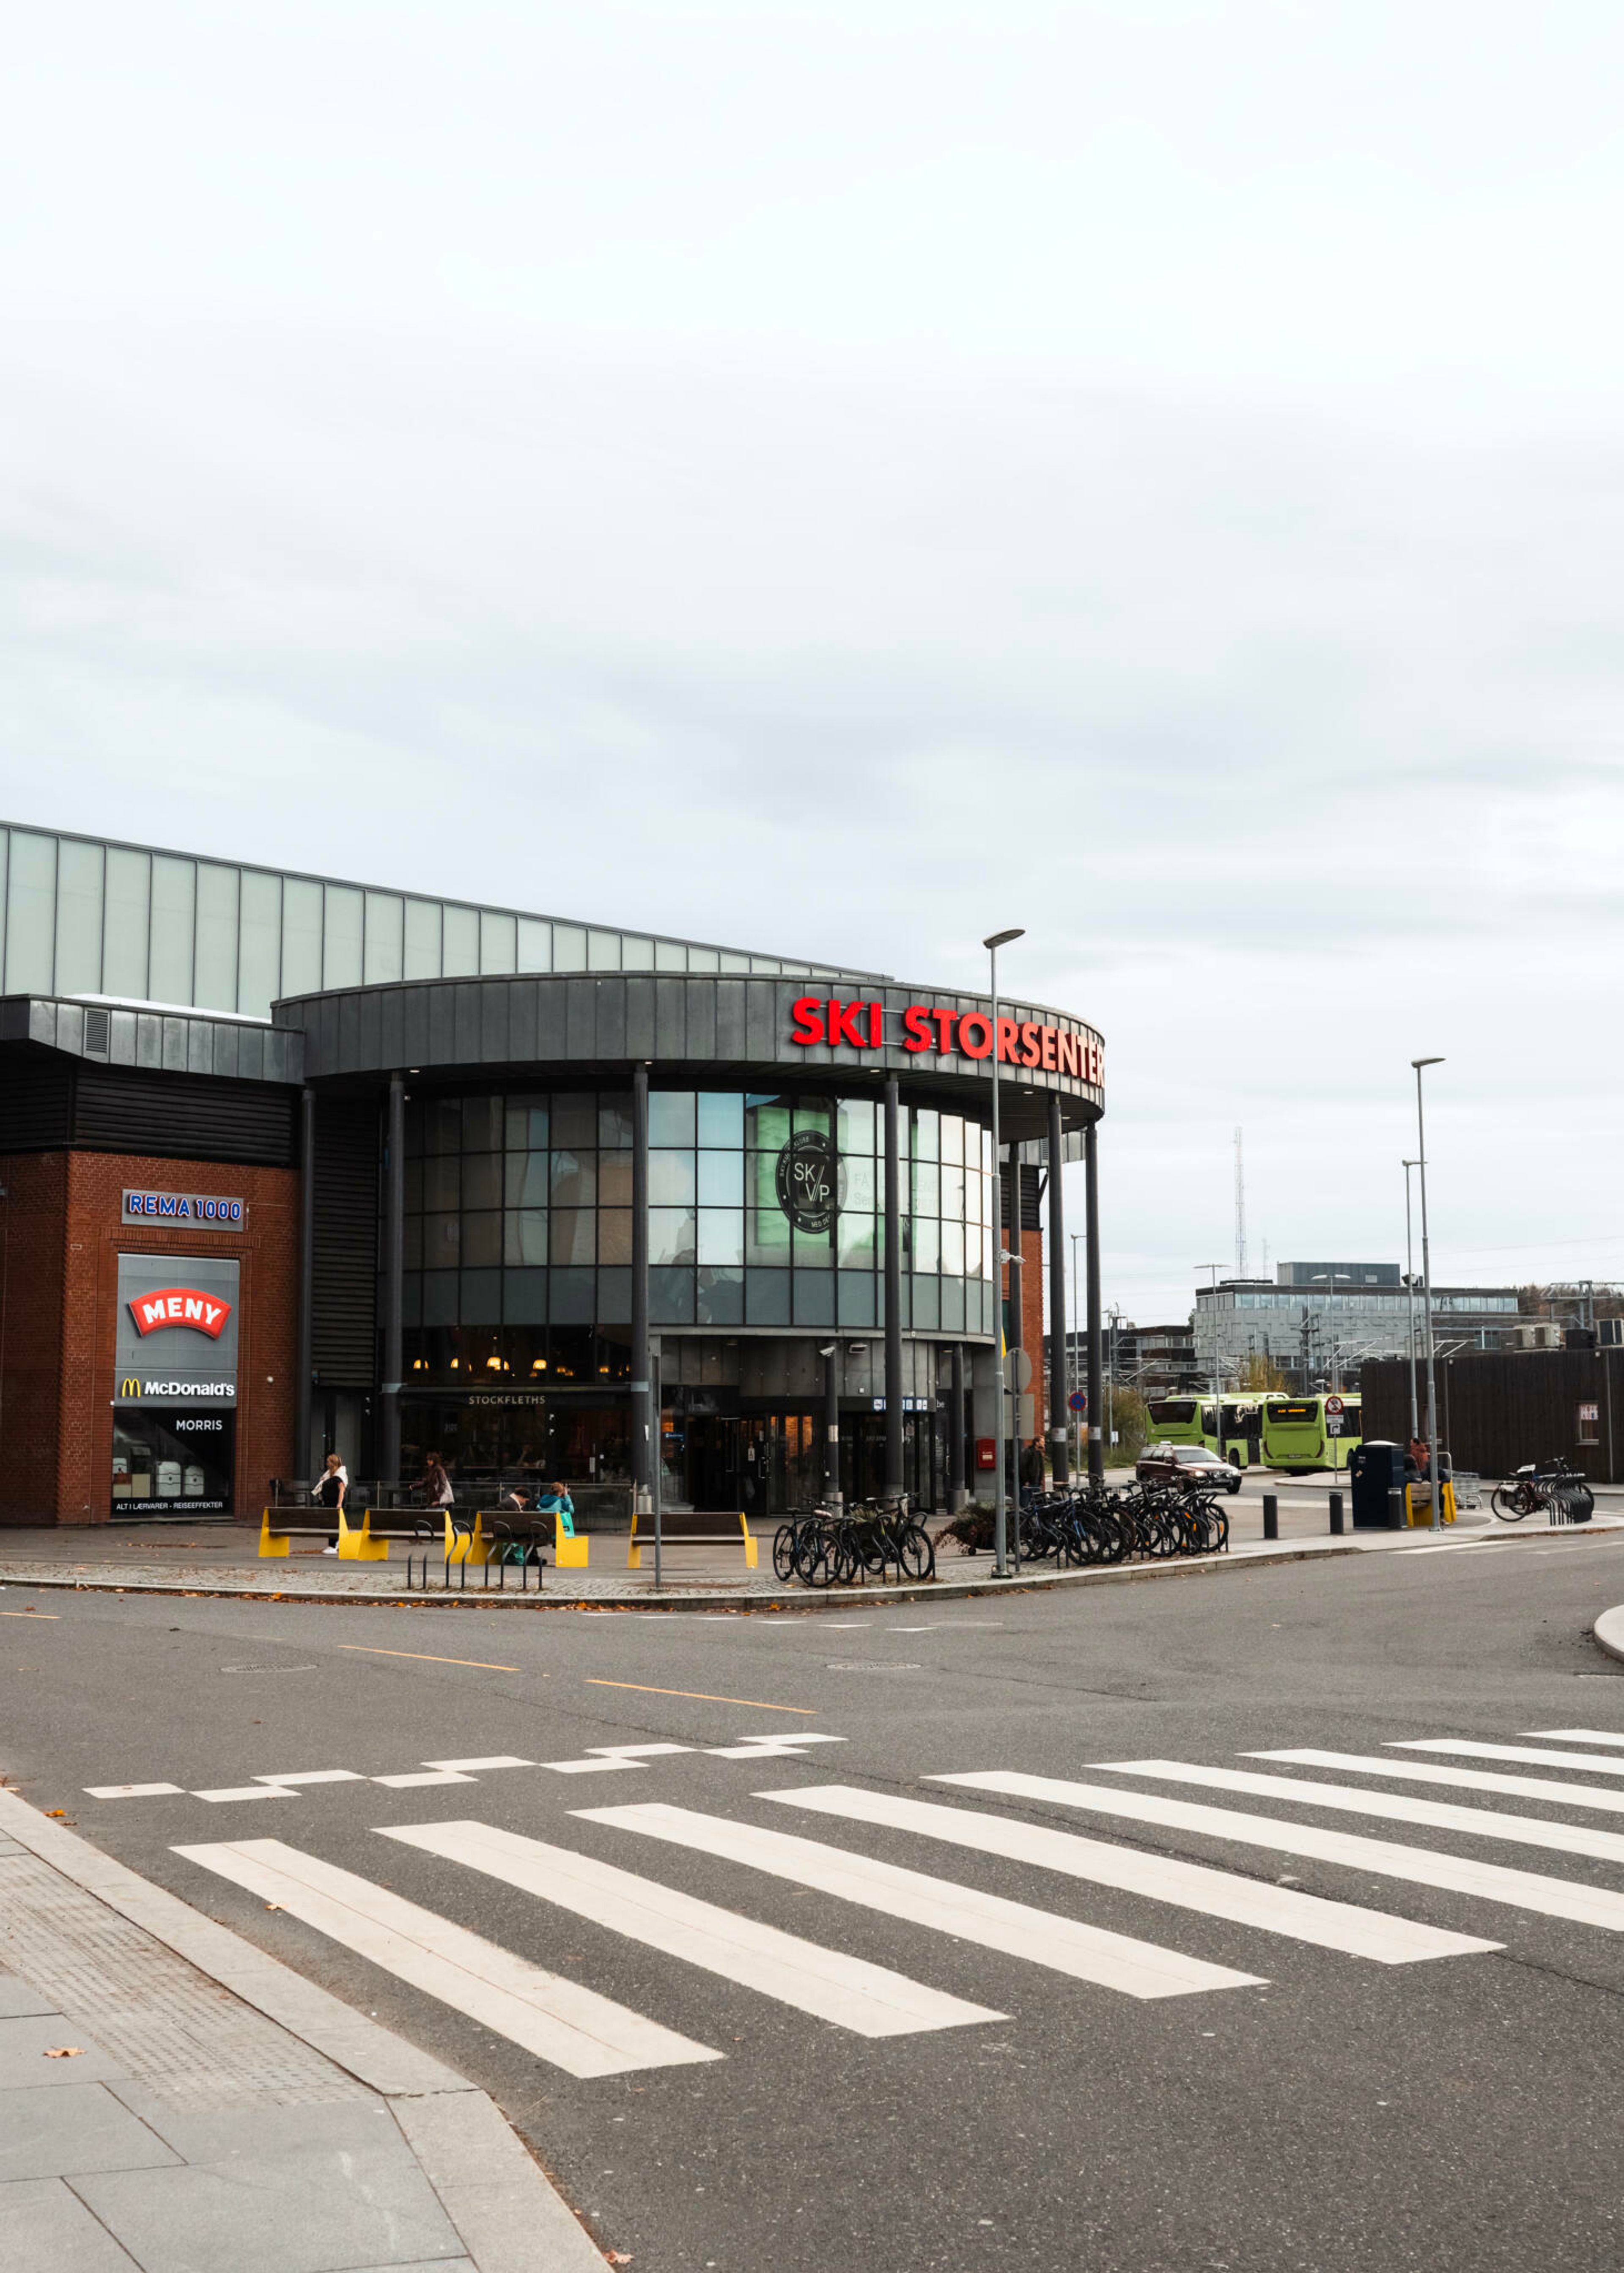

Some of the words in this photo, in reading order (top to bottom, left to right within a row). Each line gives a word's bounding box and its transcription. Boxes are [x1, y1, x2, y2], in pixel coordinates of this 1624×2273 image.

[792, 998, 882, 1048] SKI
[904, 1005, 1104, 1089] STORSENTER
[129, 1193, 190, 1217] REMA
[196, 1198, 241, 1220] 1000
[142, 1297, 222, 1325] MENY
[144, 1381, 235, 1396] McDonald's
[469, 1395, 546, 1404] STOCKFLETHS
[176, 1420, 223, 1431] MORRIS
